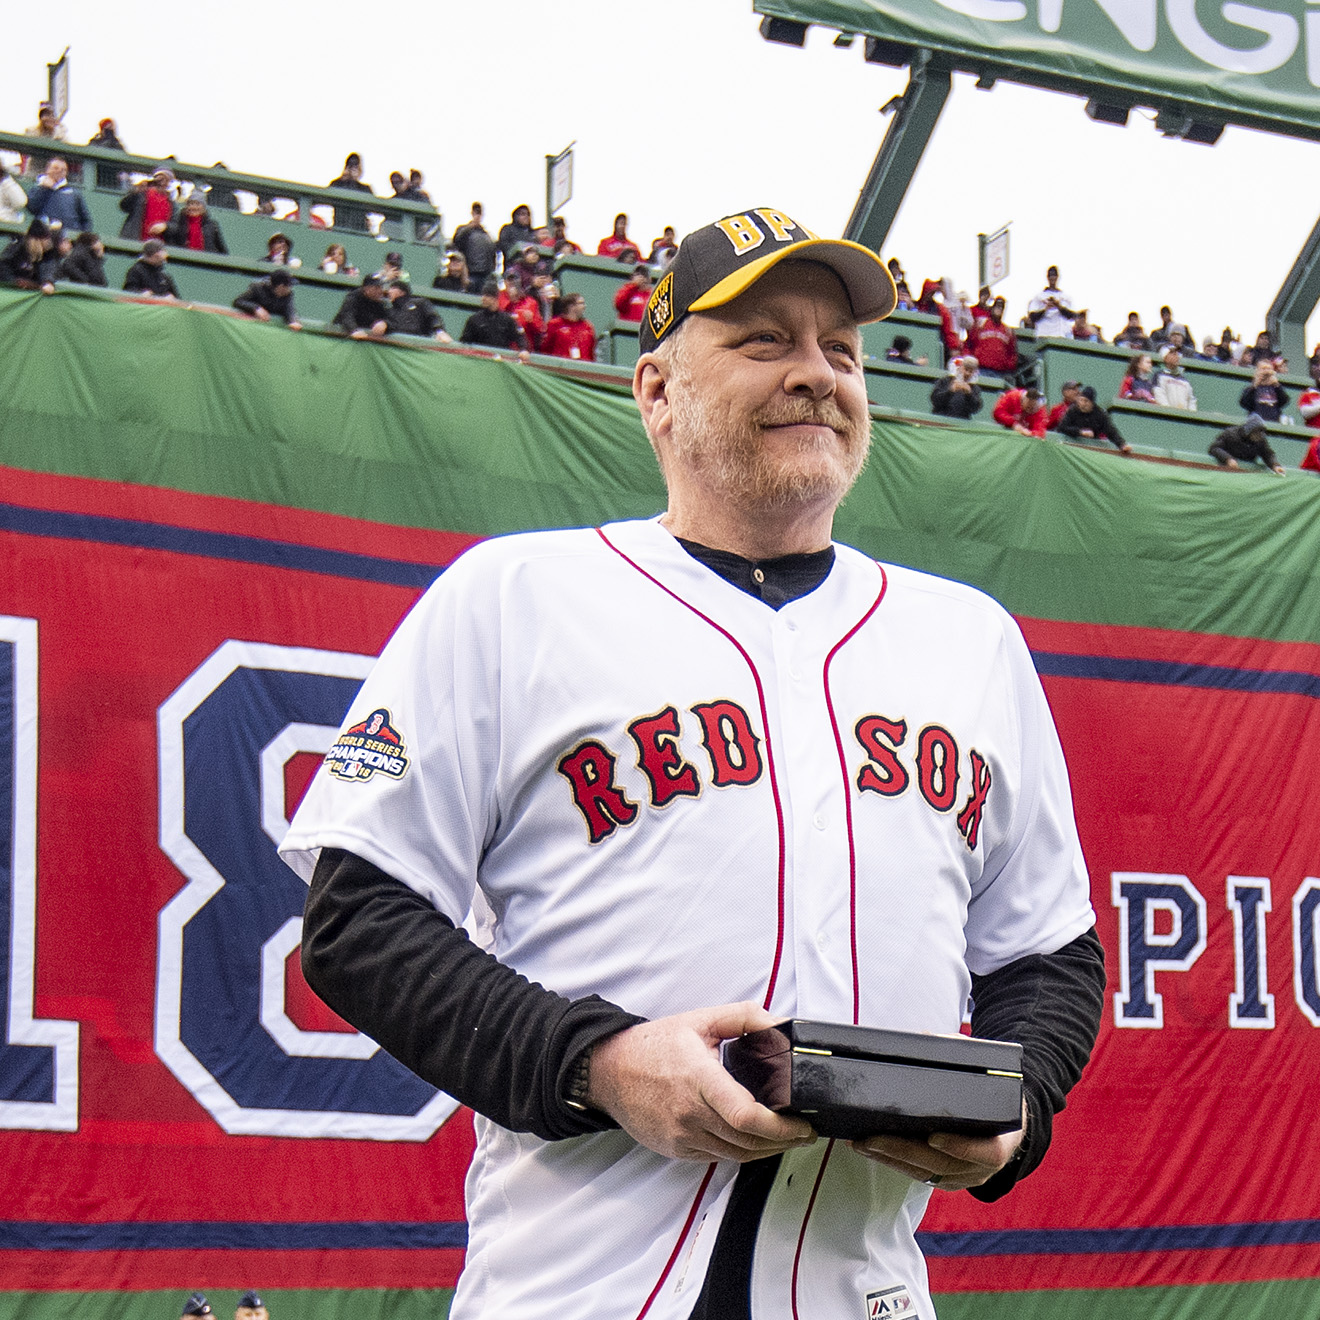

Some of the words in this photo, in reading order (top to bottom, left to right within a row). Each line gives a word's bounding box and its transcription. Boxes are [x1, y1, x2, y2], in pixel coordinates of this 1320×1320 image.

[715, 209, 818, 257] BP
[326, 745, 405, 775] CHAMPIONS
[364, 738, 401, 758] SERIES
[557, 698, 764, 846] RED
[854, 713, 992, 853] SOX
